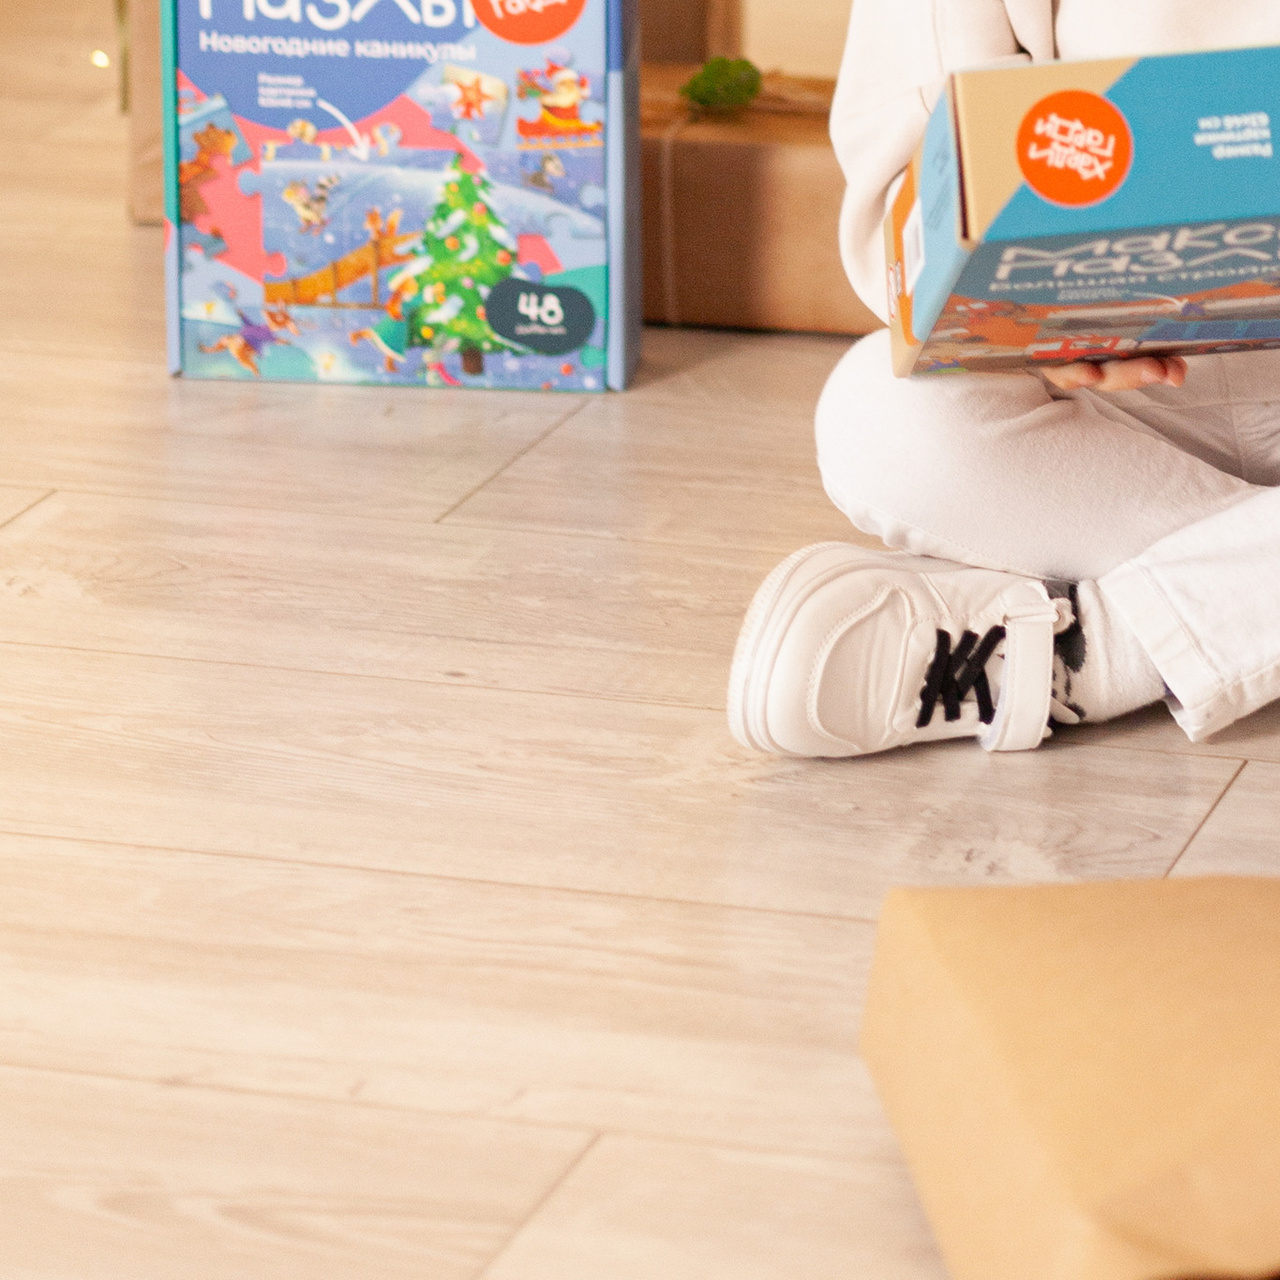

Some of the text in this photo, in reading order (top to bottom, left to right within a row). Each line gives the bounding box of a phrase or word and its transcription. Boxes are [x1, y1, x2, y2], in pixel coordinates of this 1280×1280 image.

[200, 30, 476, 64] Новогодние каникулы
[517, 291, 564, 325] 48
